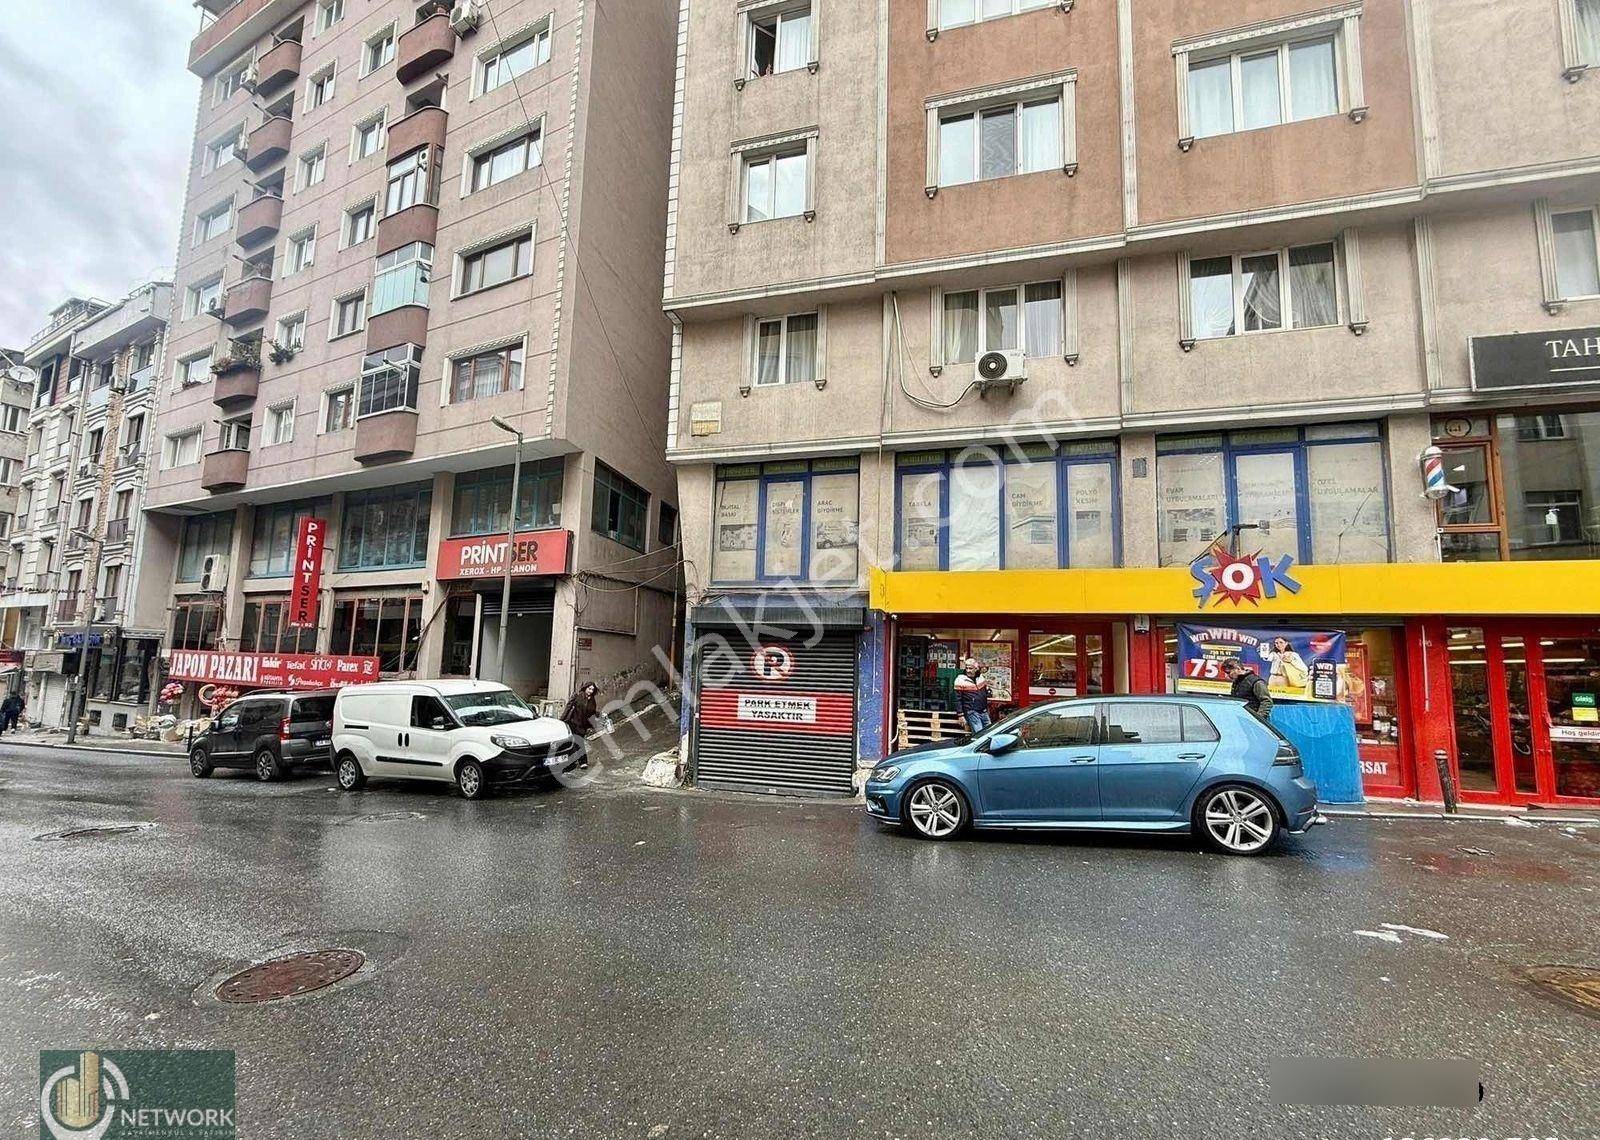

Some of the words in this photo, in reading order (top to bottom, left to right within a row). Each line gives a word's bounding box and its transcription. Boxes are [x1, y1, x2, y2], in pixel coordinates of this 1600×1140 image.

[1545, 337, 1600, 358] TAH
[460, 567, 485, 576] XEROX
[1190, 553, 1302, 609] ŞOK
[169, 652, 208, 677] JAPON
[210, 654, 259, 682] PAZARI
[336, 660, 359, 672] Parex
[744, 699, 771, 708] PARK
[775, 701, 811, 710] ETMEK
[751, 710, 804, 720] YASAKTIR
